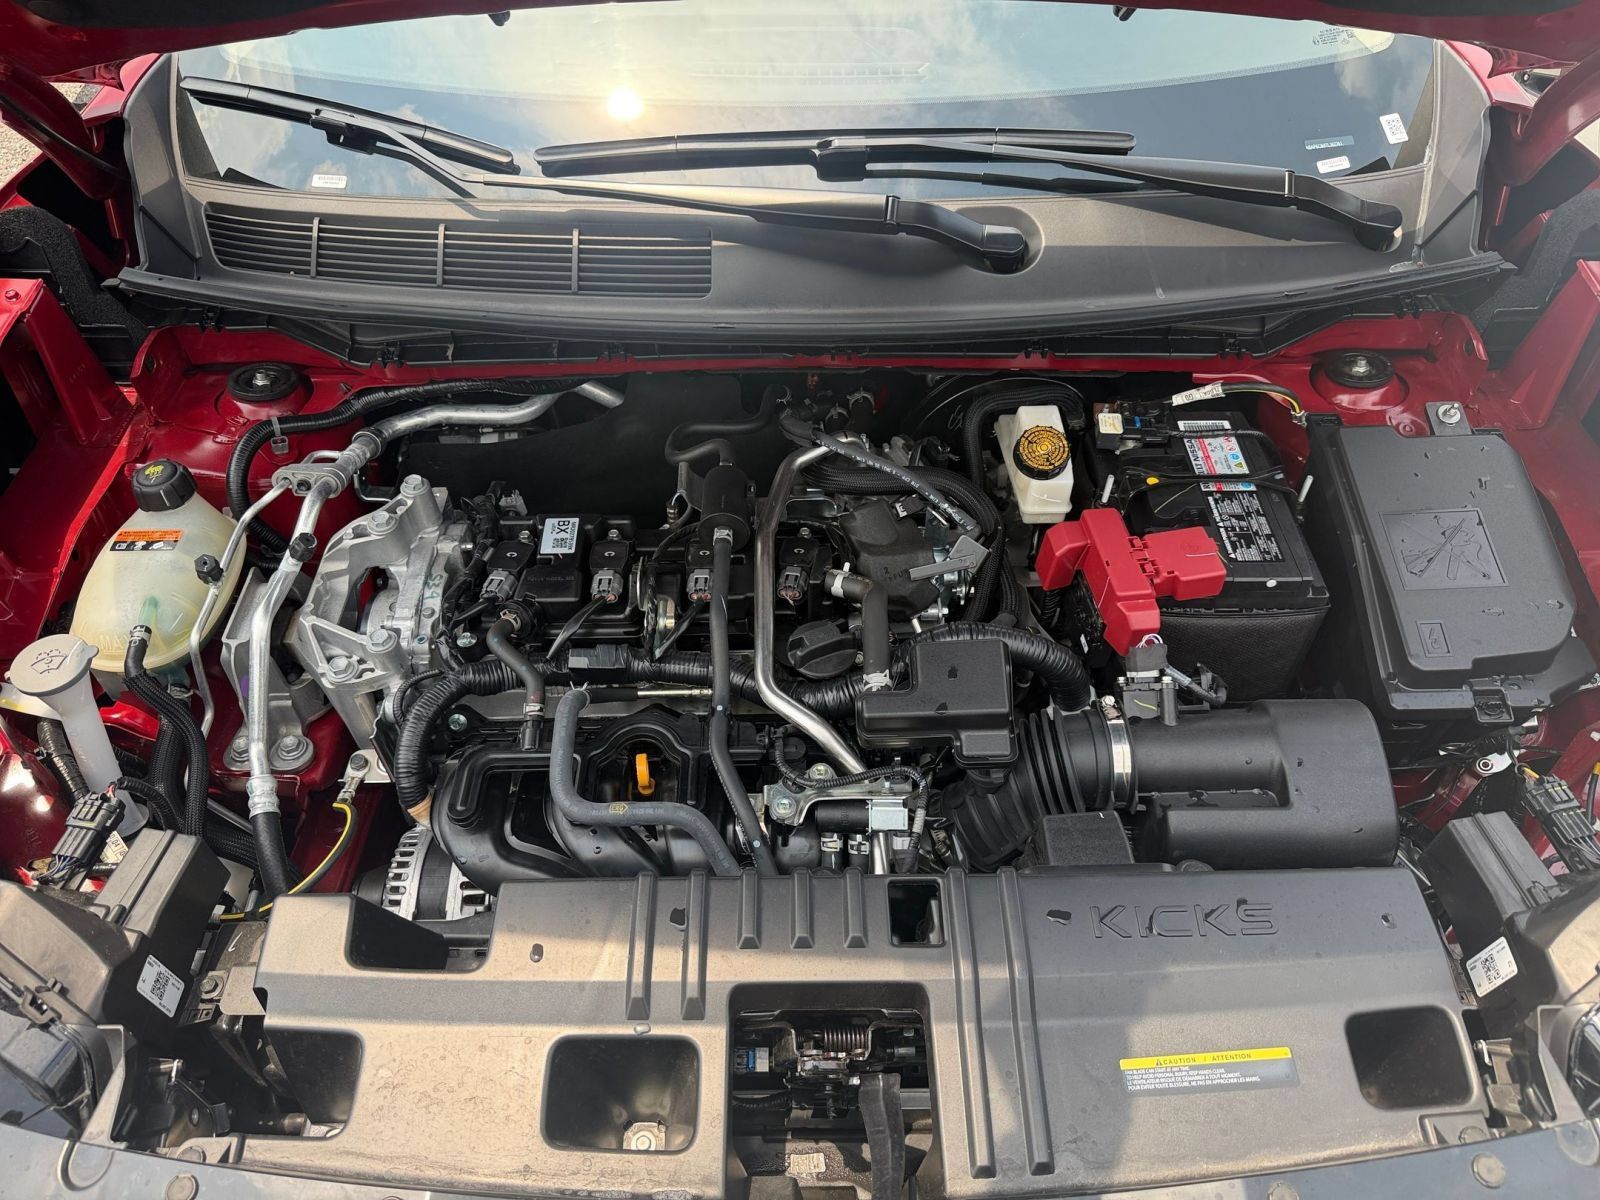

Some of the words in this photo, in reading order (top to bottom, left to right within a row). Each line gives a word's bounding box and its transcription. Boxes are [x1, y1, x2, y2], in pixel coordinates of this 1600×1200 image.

[1186, 439, 1200, 462] NISSA
[556, 520, 570, 534] BX
[1090, 903, 1279, 938] KICKS
